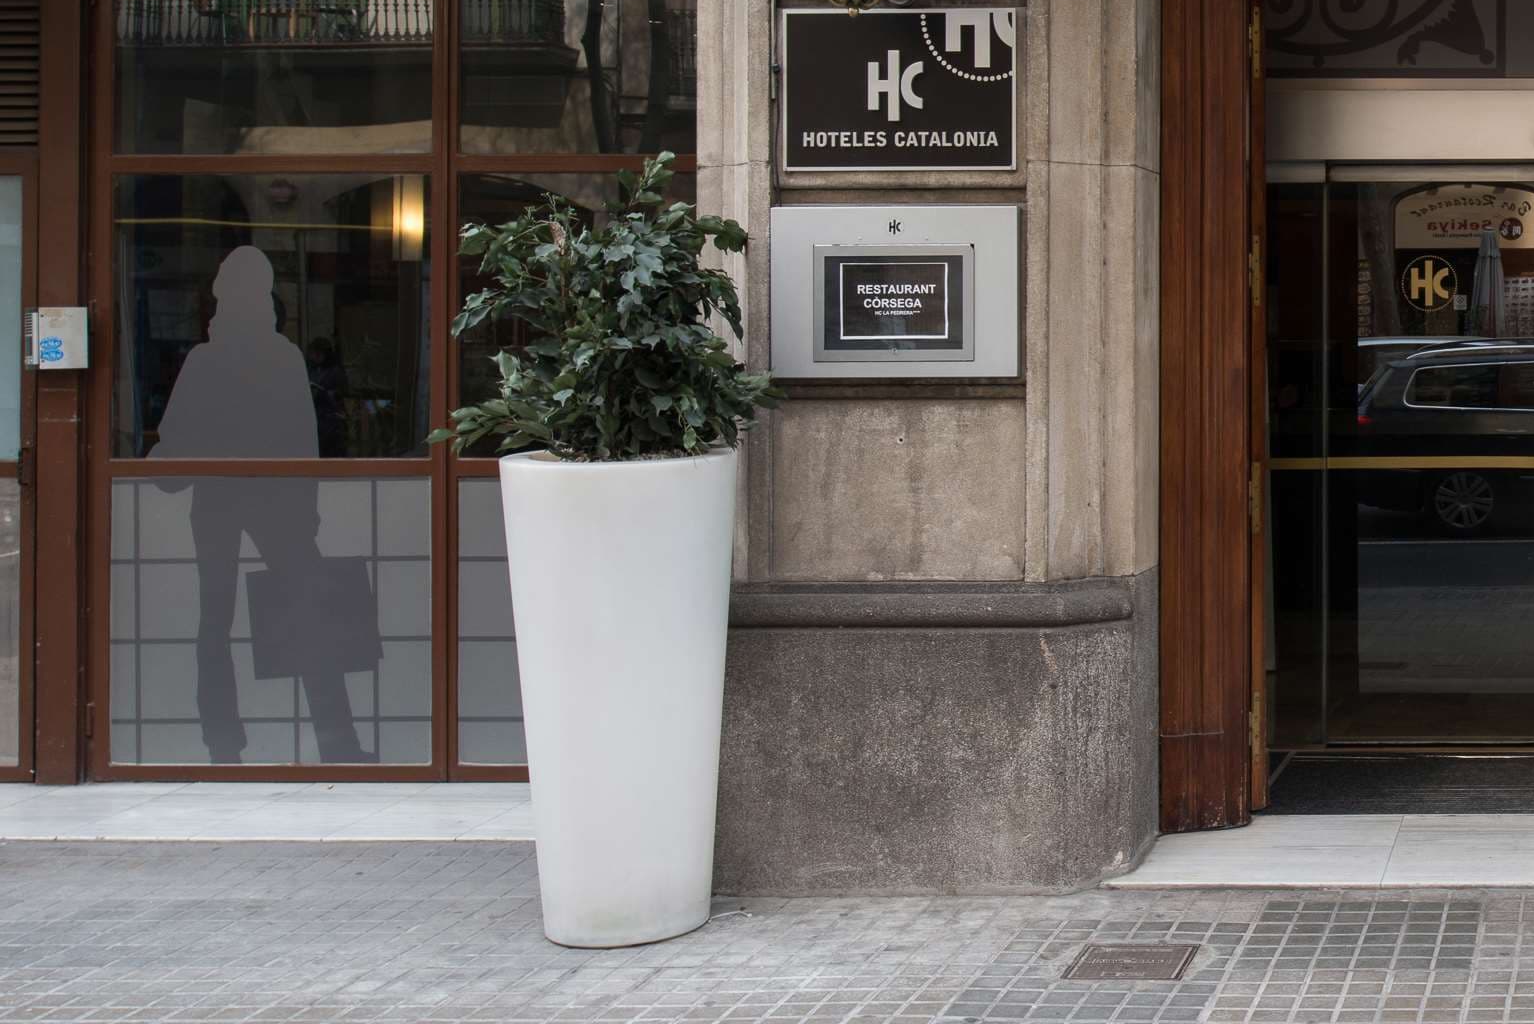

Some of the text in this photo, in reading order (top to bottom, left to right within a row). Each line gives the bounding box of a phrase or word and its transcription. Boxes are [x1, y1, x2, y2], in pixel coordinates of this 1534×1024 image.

[867, 49, 924, 122] HC
[802, 131, 999, 148] HOTELES CATALONIA
[888, 219, 902, 235] HC
[856, 284, 937, 295] RESTAURANT
[1410, 259, 1449, 306] HC
[863, 296, 922, 309] CÒRSEGA
